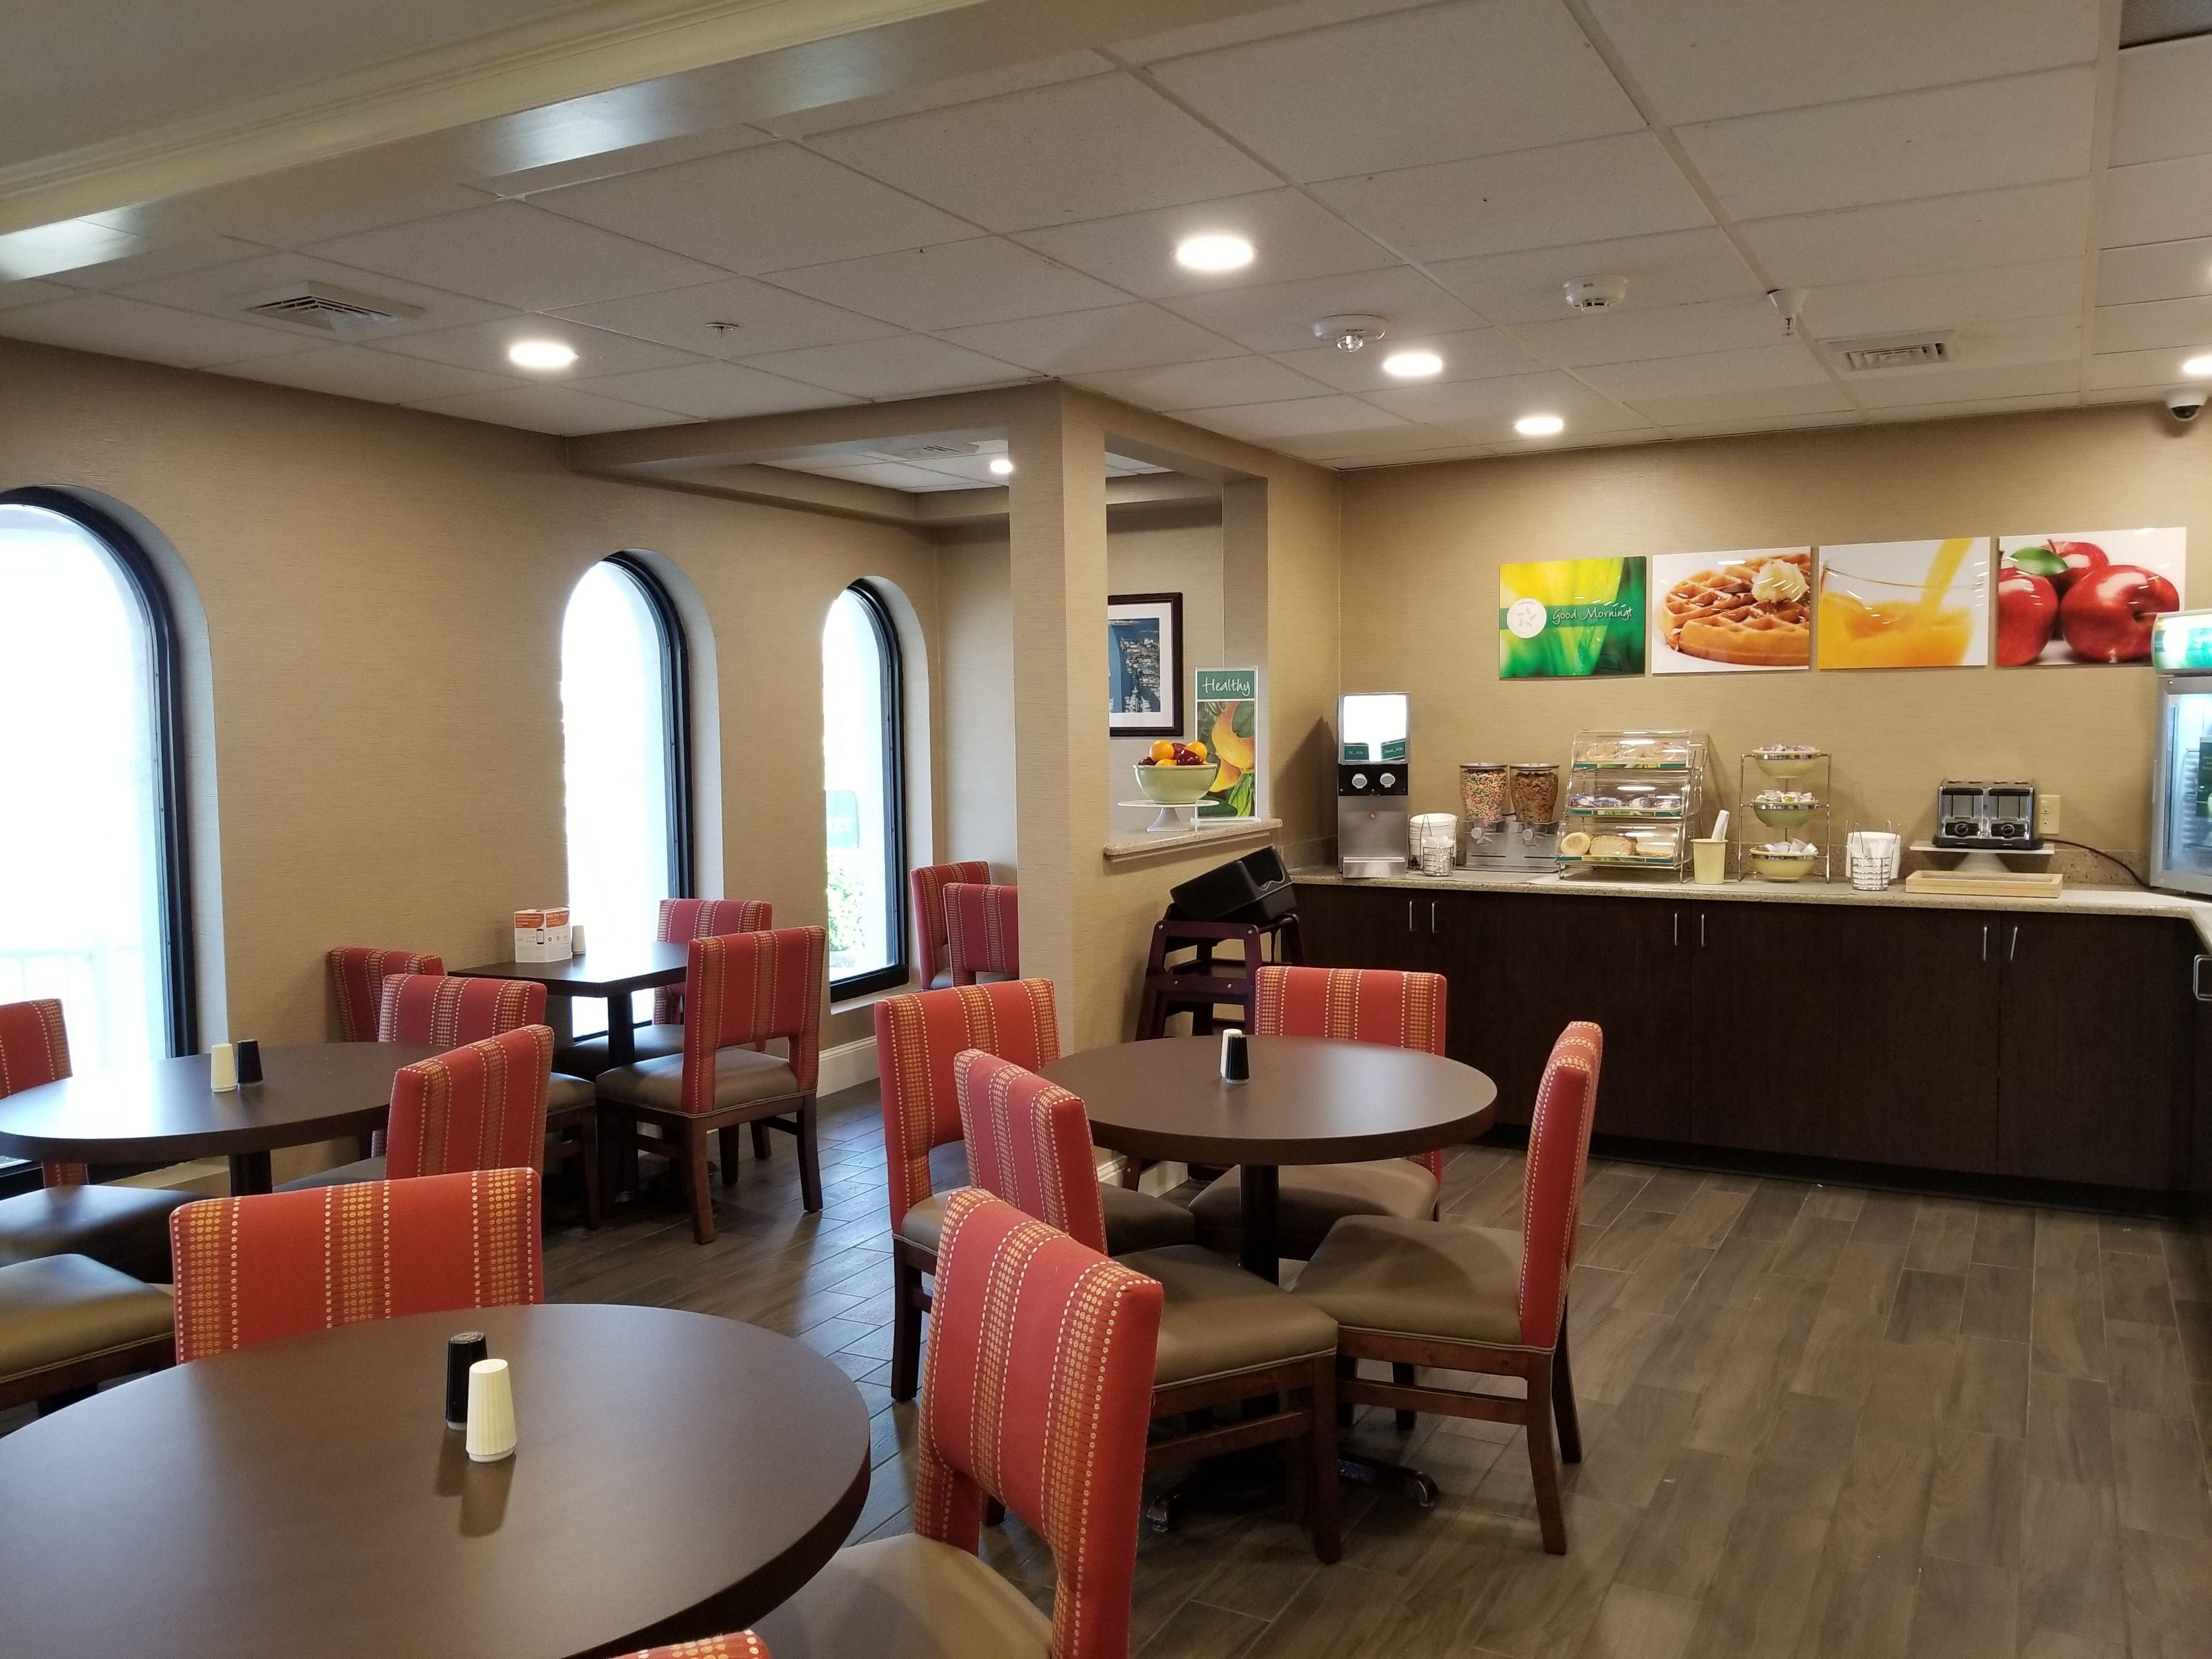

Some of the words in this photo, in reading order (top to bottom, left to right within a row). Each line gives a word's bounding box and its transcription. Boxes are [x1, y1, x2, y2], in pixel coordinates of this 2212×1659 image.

[1552, 608, 1577, 625] Good
[1578, 607, 1633, 621] Morning!
[1201, 677, 1251, 696] Healthy
